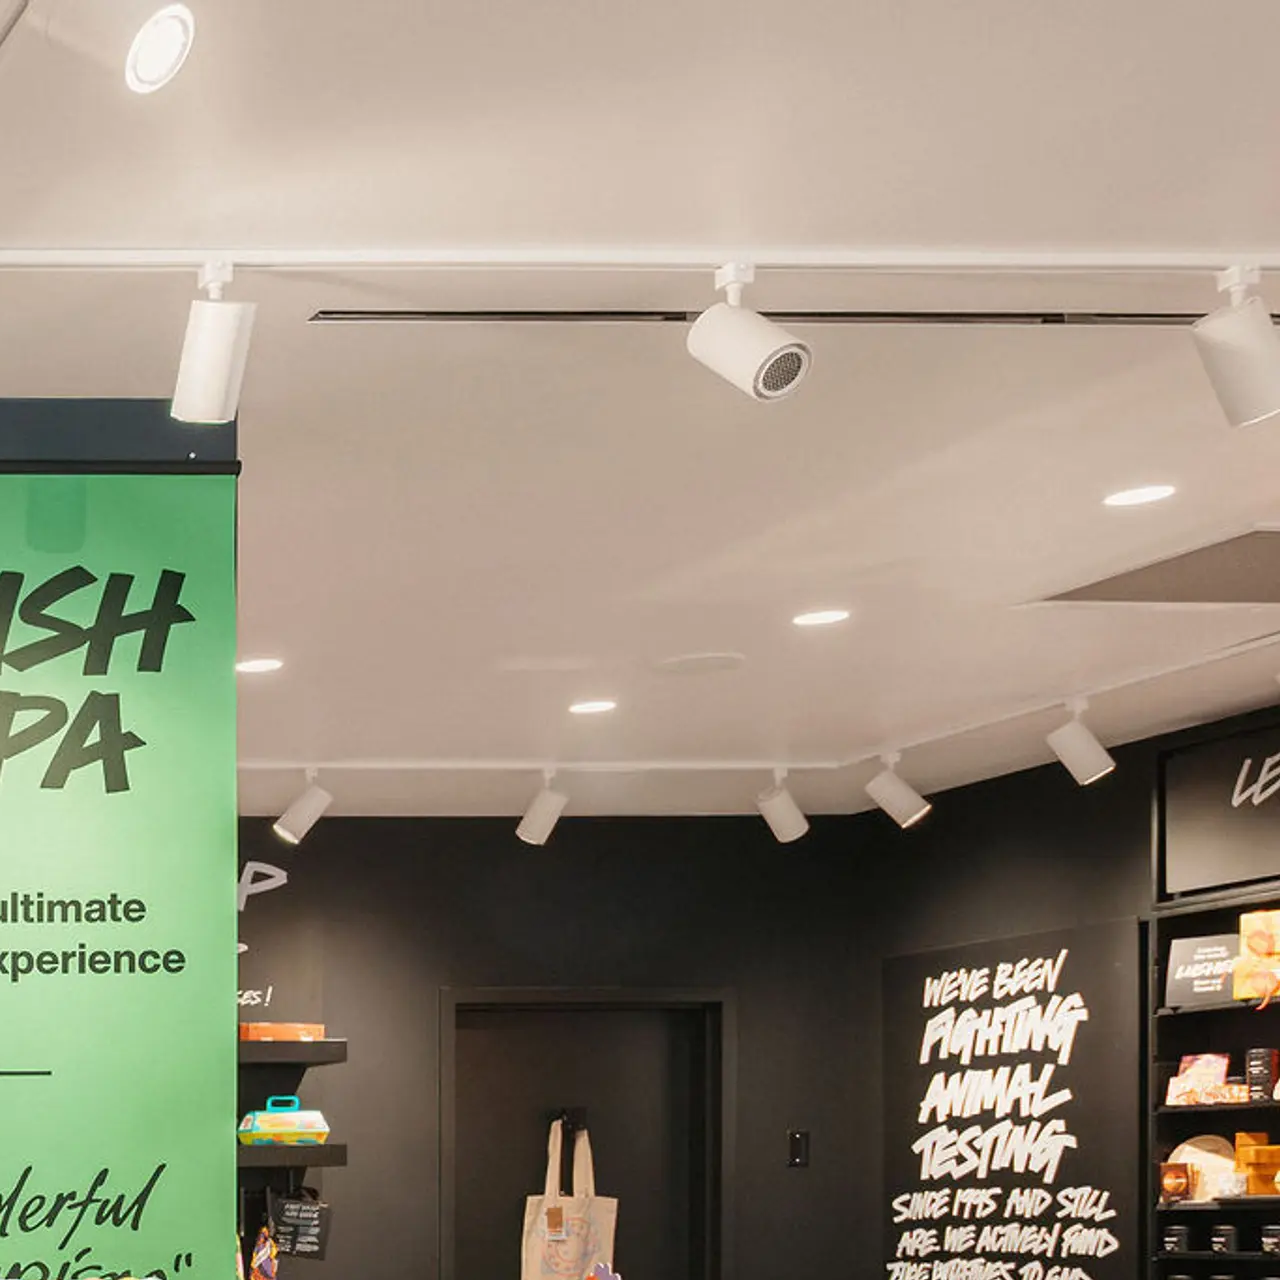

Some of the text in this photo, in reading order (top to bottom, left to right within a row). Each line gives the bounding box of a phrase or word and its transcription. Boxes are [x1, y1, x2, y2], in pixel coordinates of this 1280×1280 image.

[993, 949, 1068, 999] BEEN
[920, 993, 1089, 1065] FIGHTING
[918, 1063, 1073, 1124] ANIMAL
[911, 1120, 1077, 1184] TESTING
[1004, 1188, 1052, 1218] AND
[1057, 1186, 1117, 1222] STILL
[896, 1228, 941, 1258] ARE
[944, 1225, 977, 1253] WE
[975, 1222, 1062, 1258] ACTIVELY
